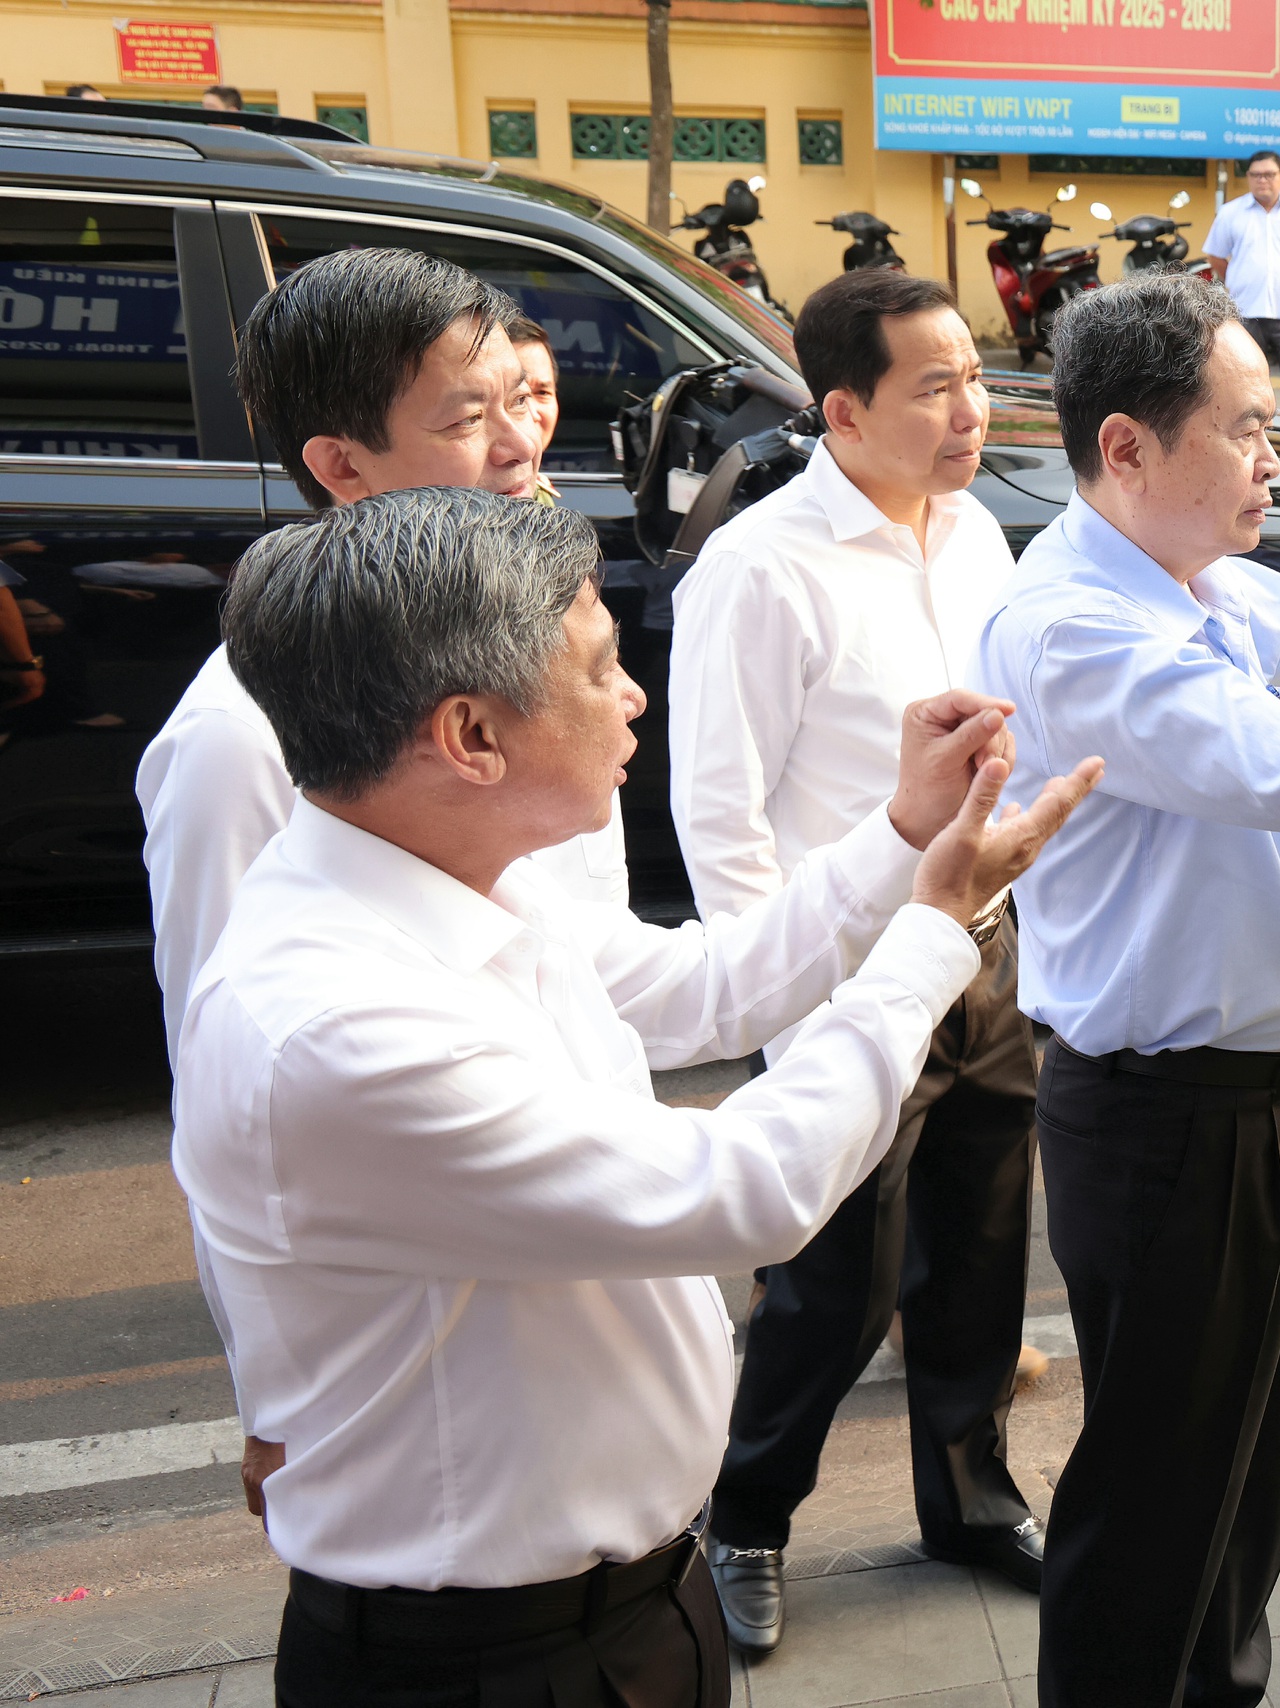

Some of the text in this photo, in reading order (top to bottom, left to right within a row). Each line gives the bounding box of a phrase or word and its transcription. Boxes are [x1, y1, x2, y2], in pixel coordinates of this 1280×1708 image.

[1120, 0, 1165, 29] 2025
[884, 93, 1072, 120] INTERNET WIFI VNPT
